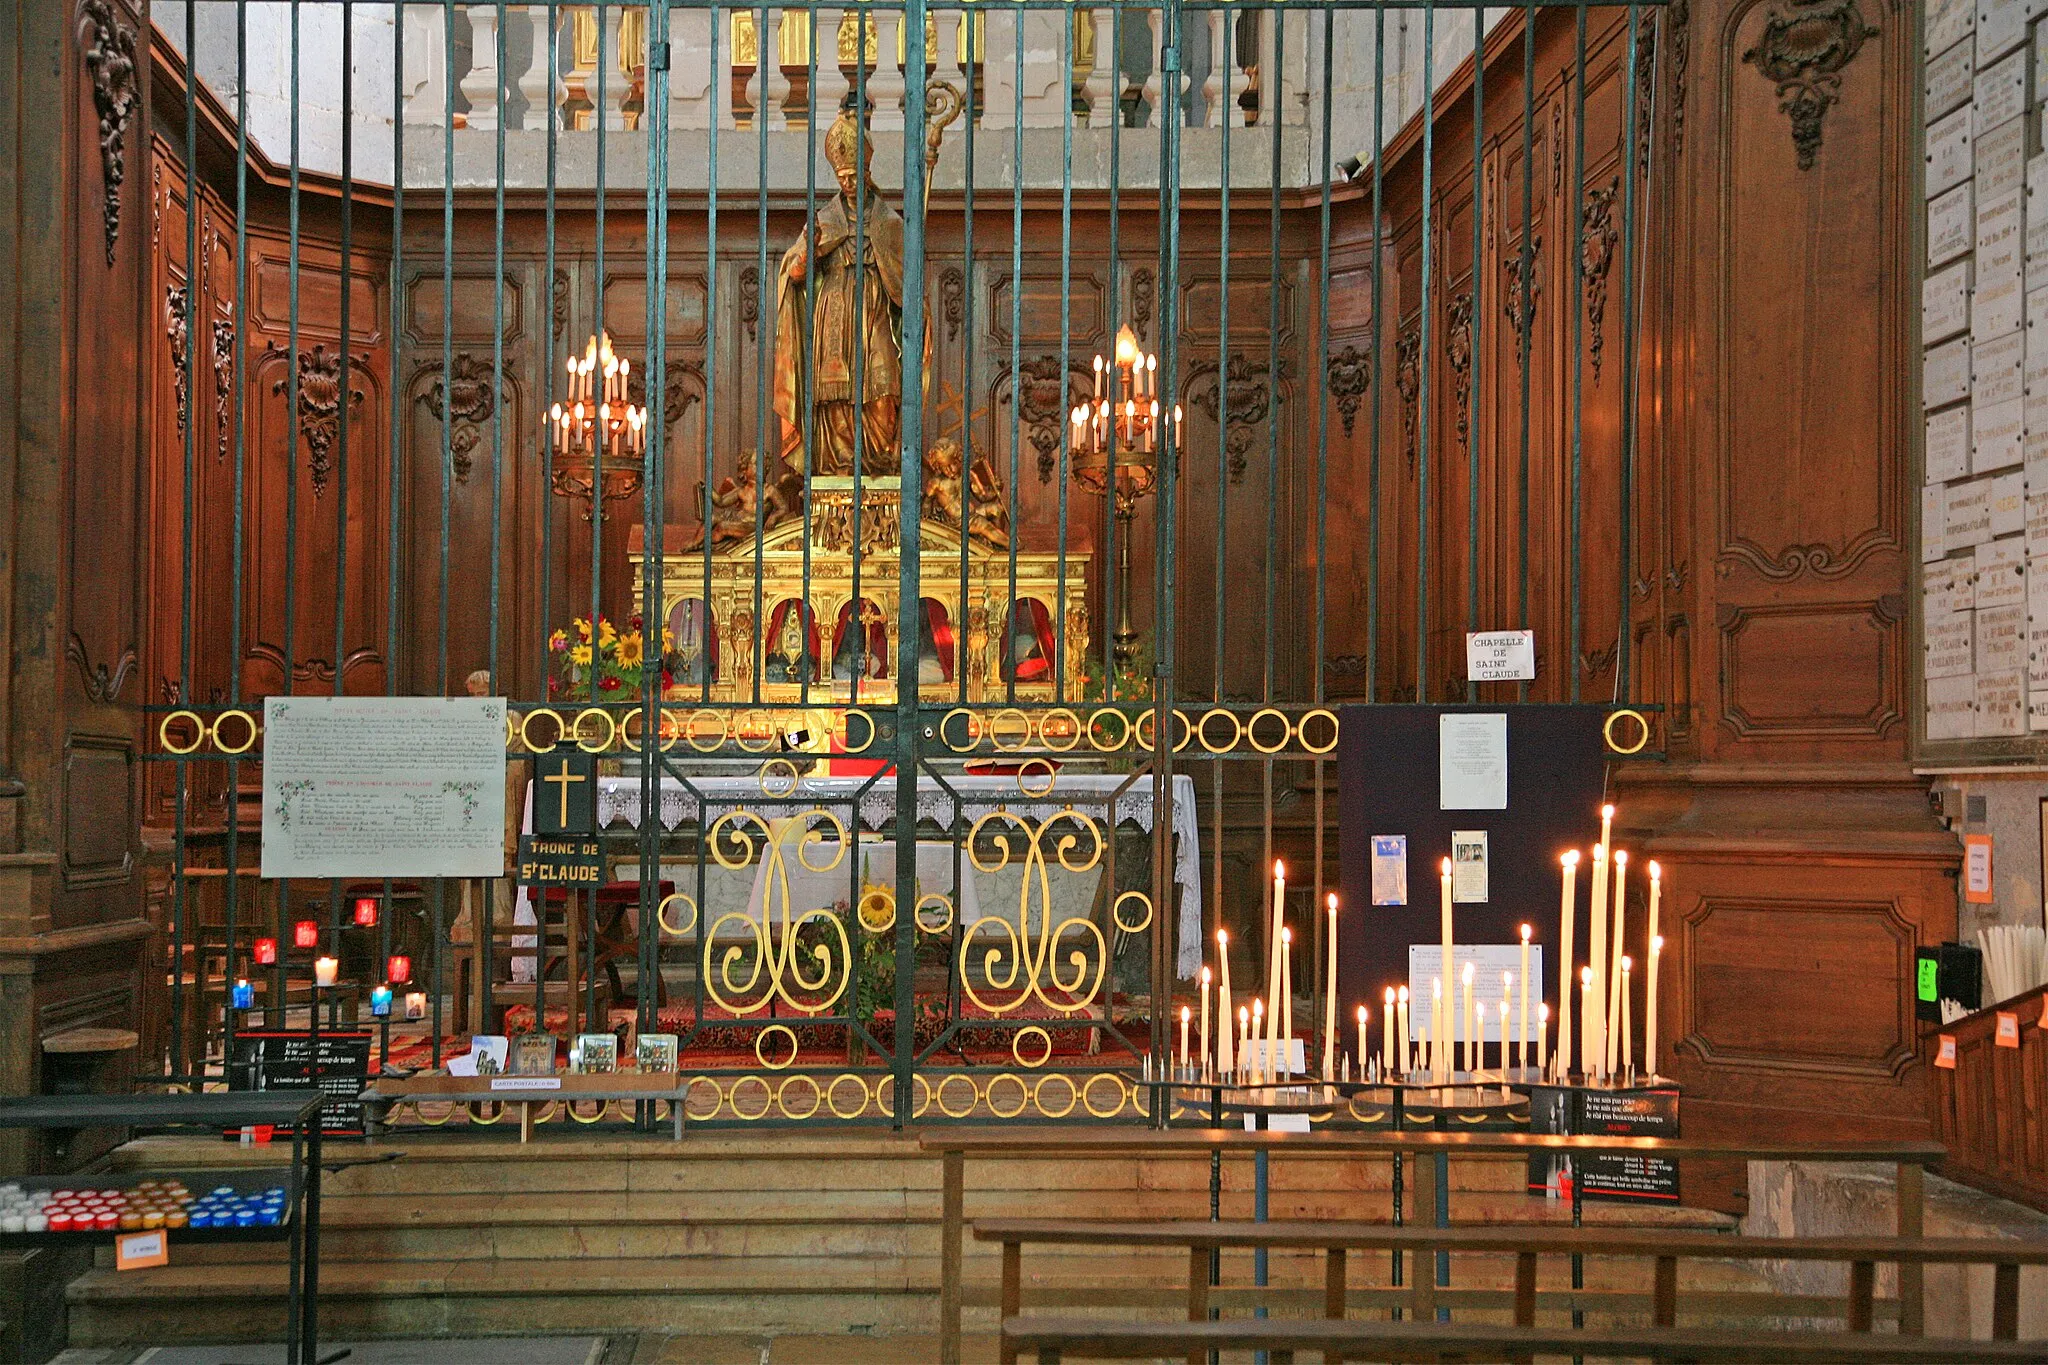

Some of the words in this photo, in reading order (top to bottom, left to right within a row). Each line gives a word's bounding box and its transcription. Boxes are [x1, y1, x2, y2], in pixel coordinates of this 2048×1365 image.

[1474, 638, 1524, 647] CHAPELLE
[1475, 660, 1506, 668] SAINT
[1482, 670, 1520, 679] CLAUDE
[530, 841, 575, 855] TRONC
[582, 844, 598, 855] DE
[540, 864, 599, 881] CLAUDE
[1586, 1095, 1592, 1103] Je
[1586, 1111, 1592, 1119] Je
[1602, 1113, 1611, 1121] pas
[1612, 1113, 1638, 1122] beaucoup
[1646, 1115, 1663, 1123] temps
